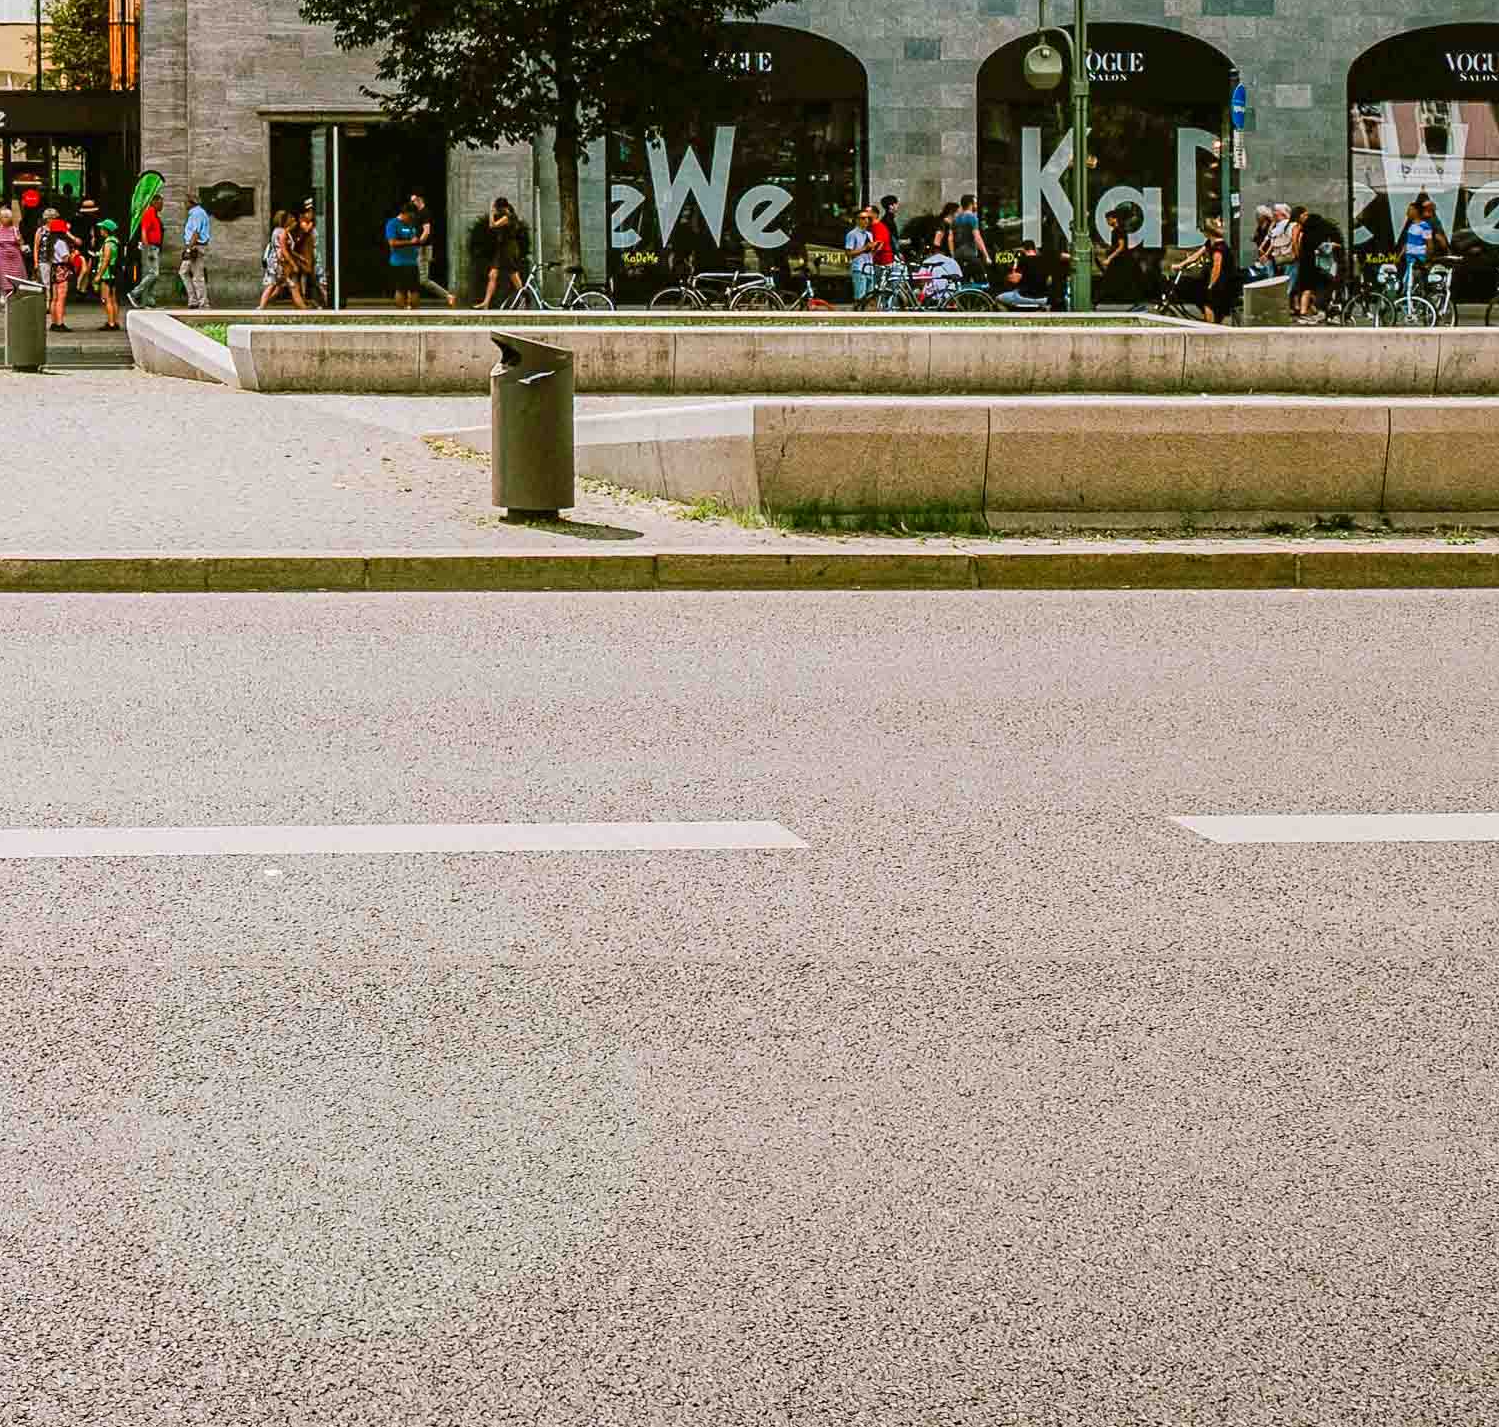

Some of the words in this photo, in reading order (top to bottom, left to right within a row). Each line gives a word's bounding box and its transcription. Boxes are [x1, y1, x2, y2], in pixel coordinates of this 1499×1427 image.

[1085, 52, 1144, 73] OGUE
[1459, 73, 1499, 82] SALON
[623, 252, 659, 264] KaDeWe
